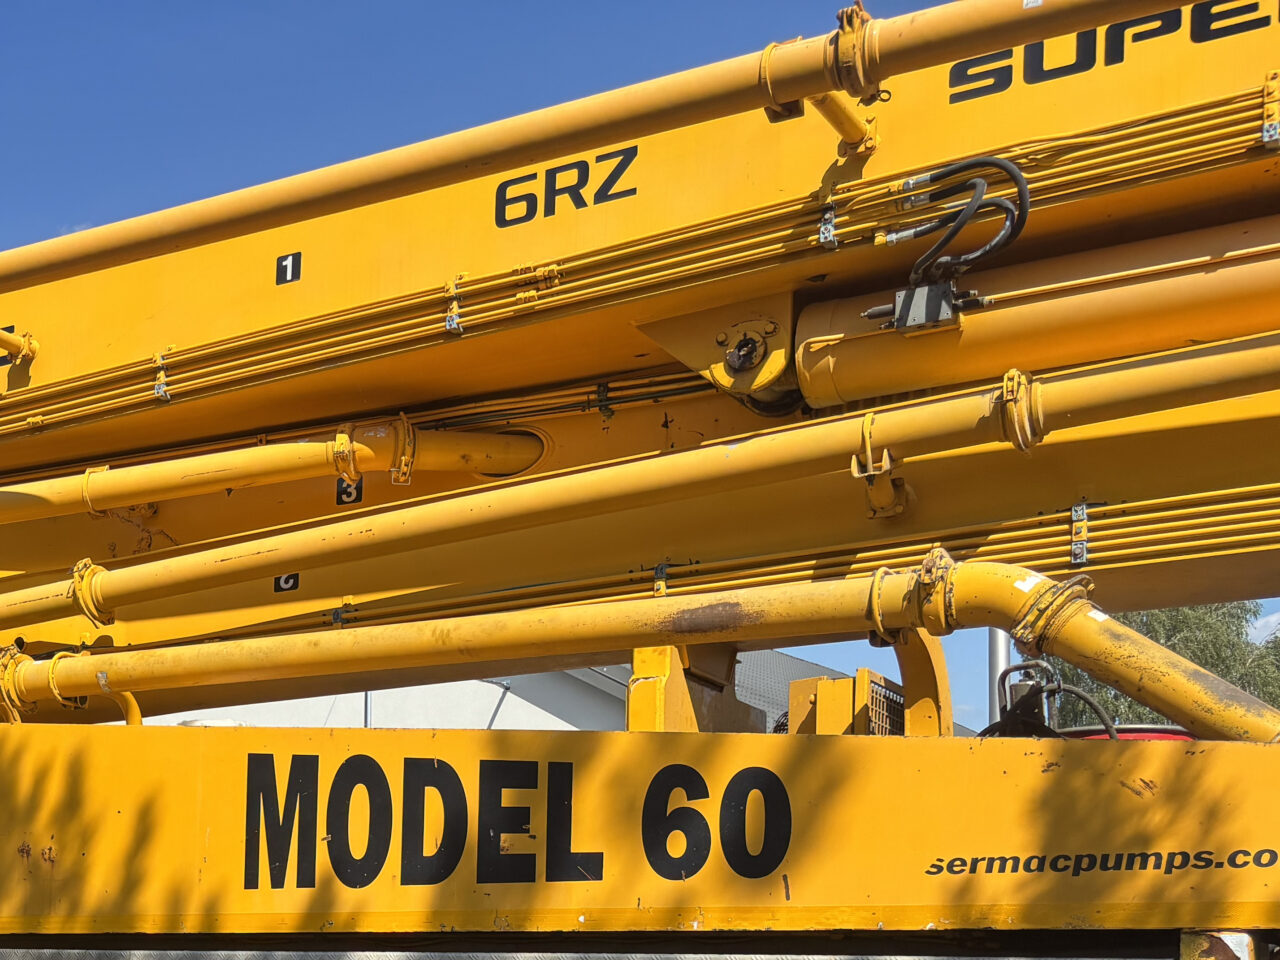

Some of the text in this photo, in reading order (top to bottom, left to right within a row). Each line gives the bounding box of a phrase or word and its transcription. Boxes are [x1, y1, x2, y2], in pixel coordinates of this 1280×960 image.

[949, 0, 1280, 104] SUPE
[495, 145, 638, 228] 6RZ
[282, 255, 293, 281] 1
[341, 479, 357, 503] 3
[244, 753, 792, 889] MODEL 60
